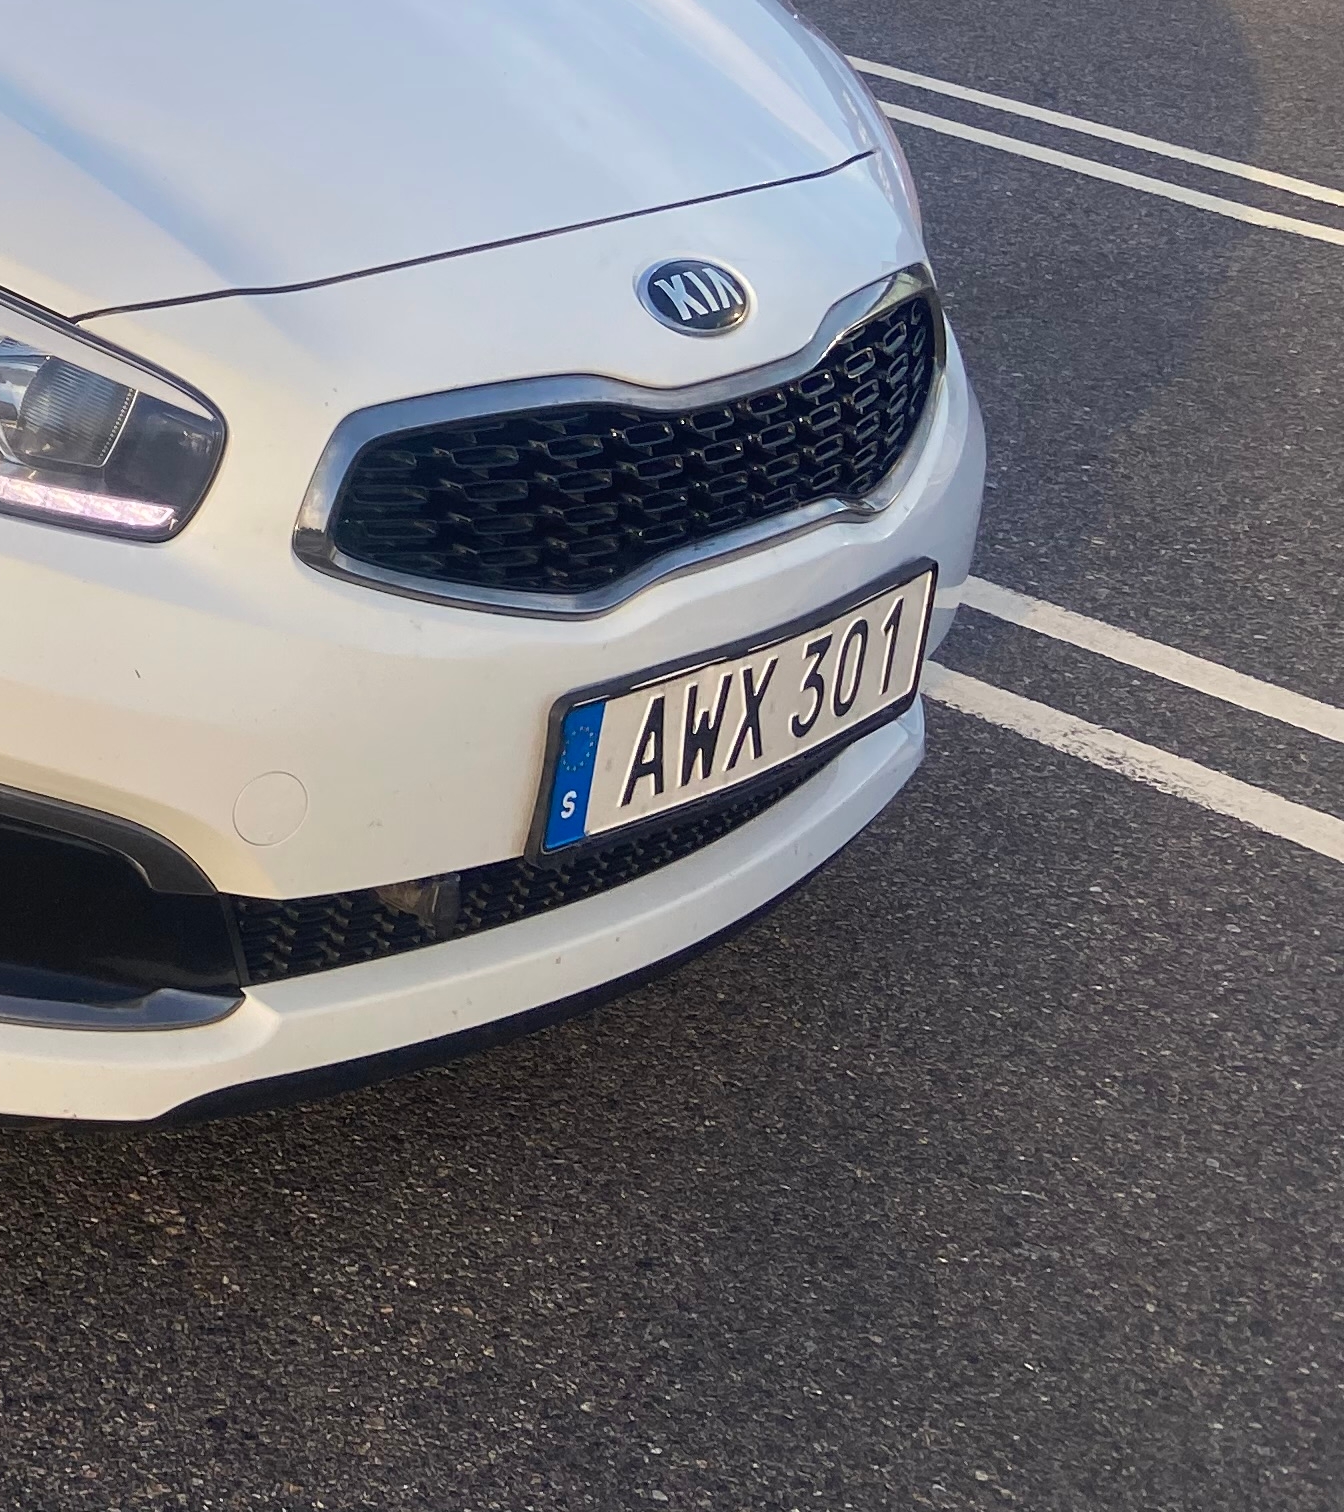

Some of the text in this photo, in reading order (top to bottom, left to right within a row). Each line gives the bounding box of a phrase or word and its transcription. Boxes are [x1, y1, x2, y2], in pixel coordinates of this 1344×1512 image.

[653, 267, 744, 321] KIA
[616, 595, 905, 807] AWX 301
[560, 790, 578, 819] S
